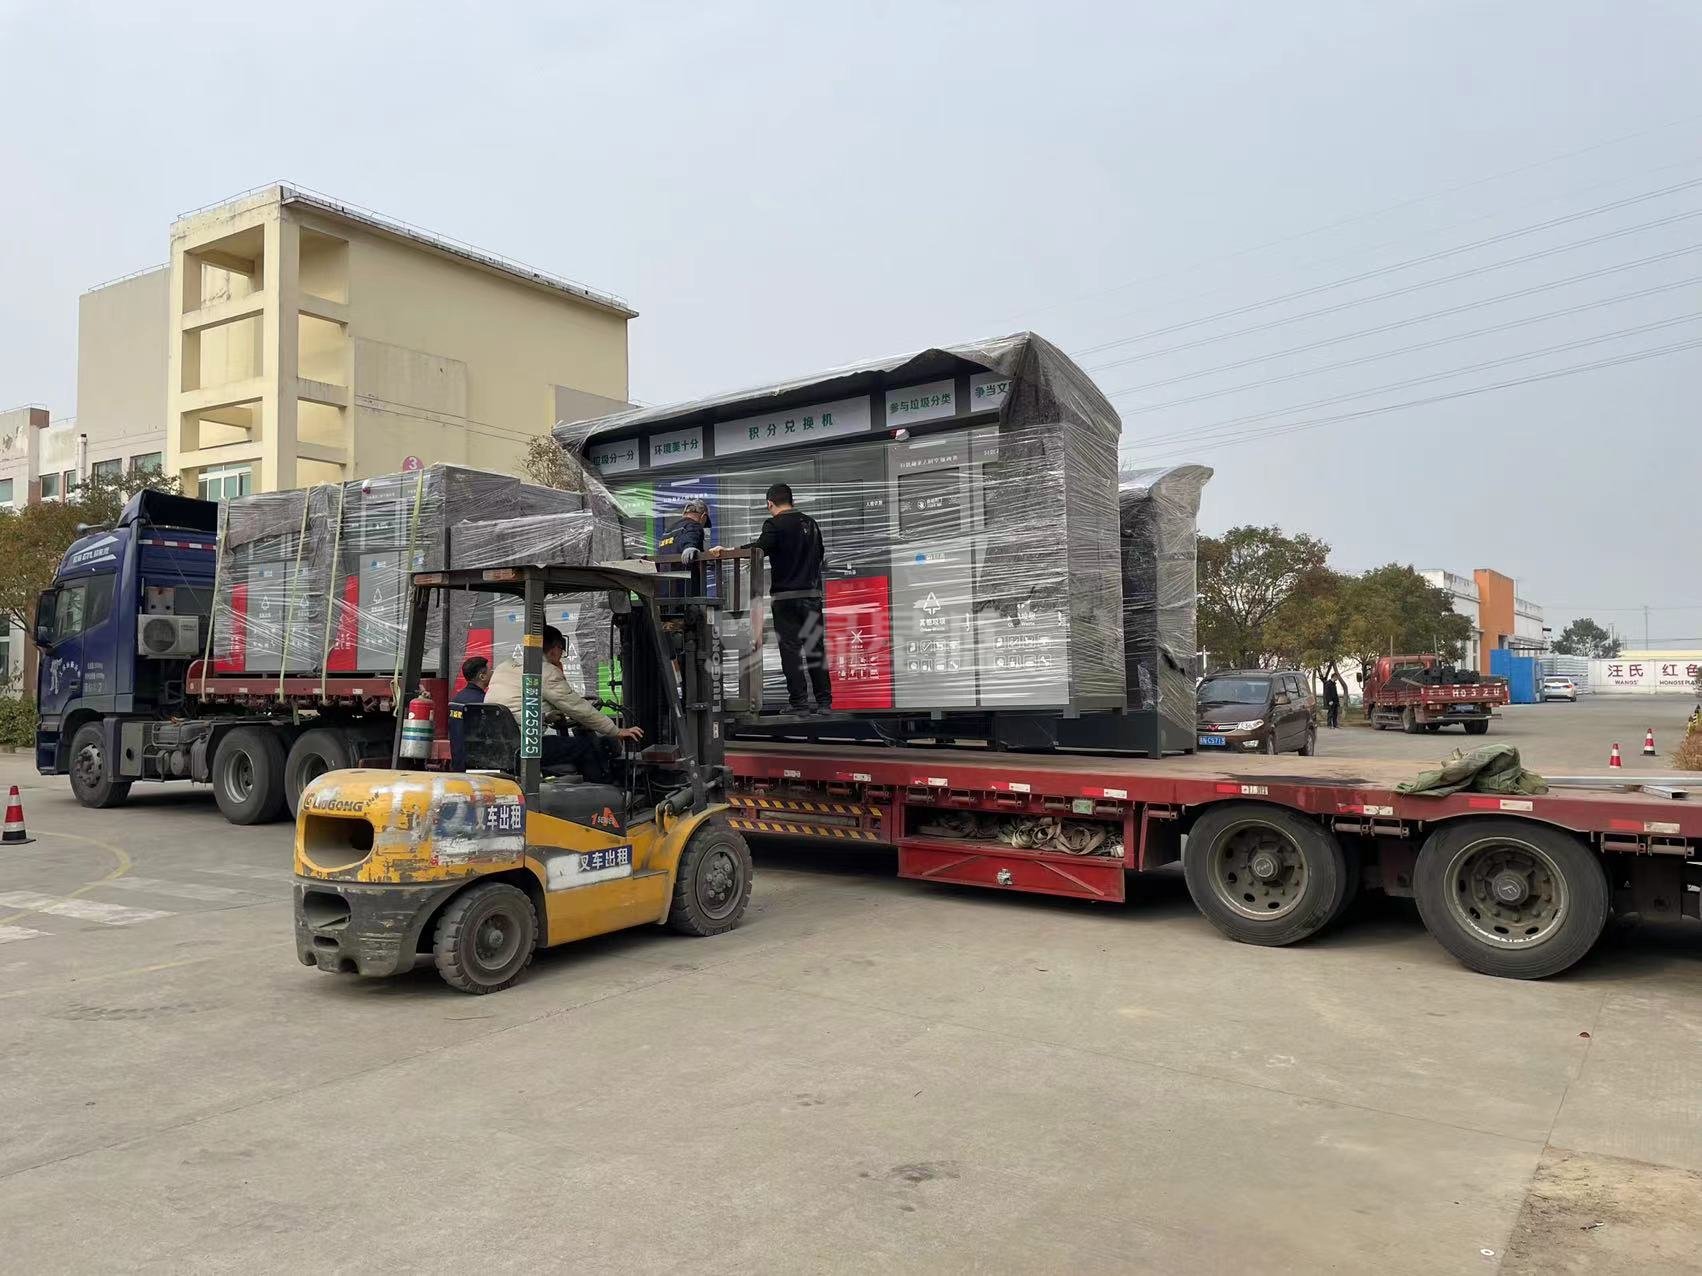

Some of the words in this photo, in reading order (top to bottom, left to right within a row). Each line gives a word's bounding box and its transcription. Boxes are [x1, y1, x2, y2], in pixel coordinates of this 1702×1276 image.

[975, 380, 1013, 399] 争当文
[889, 391, 952, 414] 参与垃圾分类
[748, 412, 833, 440] 积分兑换机
[408, 456, 418, 470] 3
[1607, 664, 1644, 678] 汪氏
[1662, 663, 1698, 678] 红色
[580, 847, 629, 873] 叉车出租
